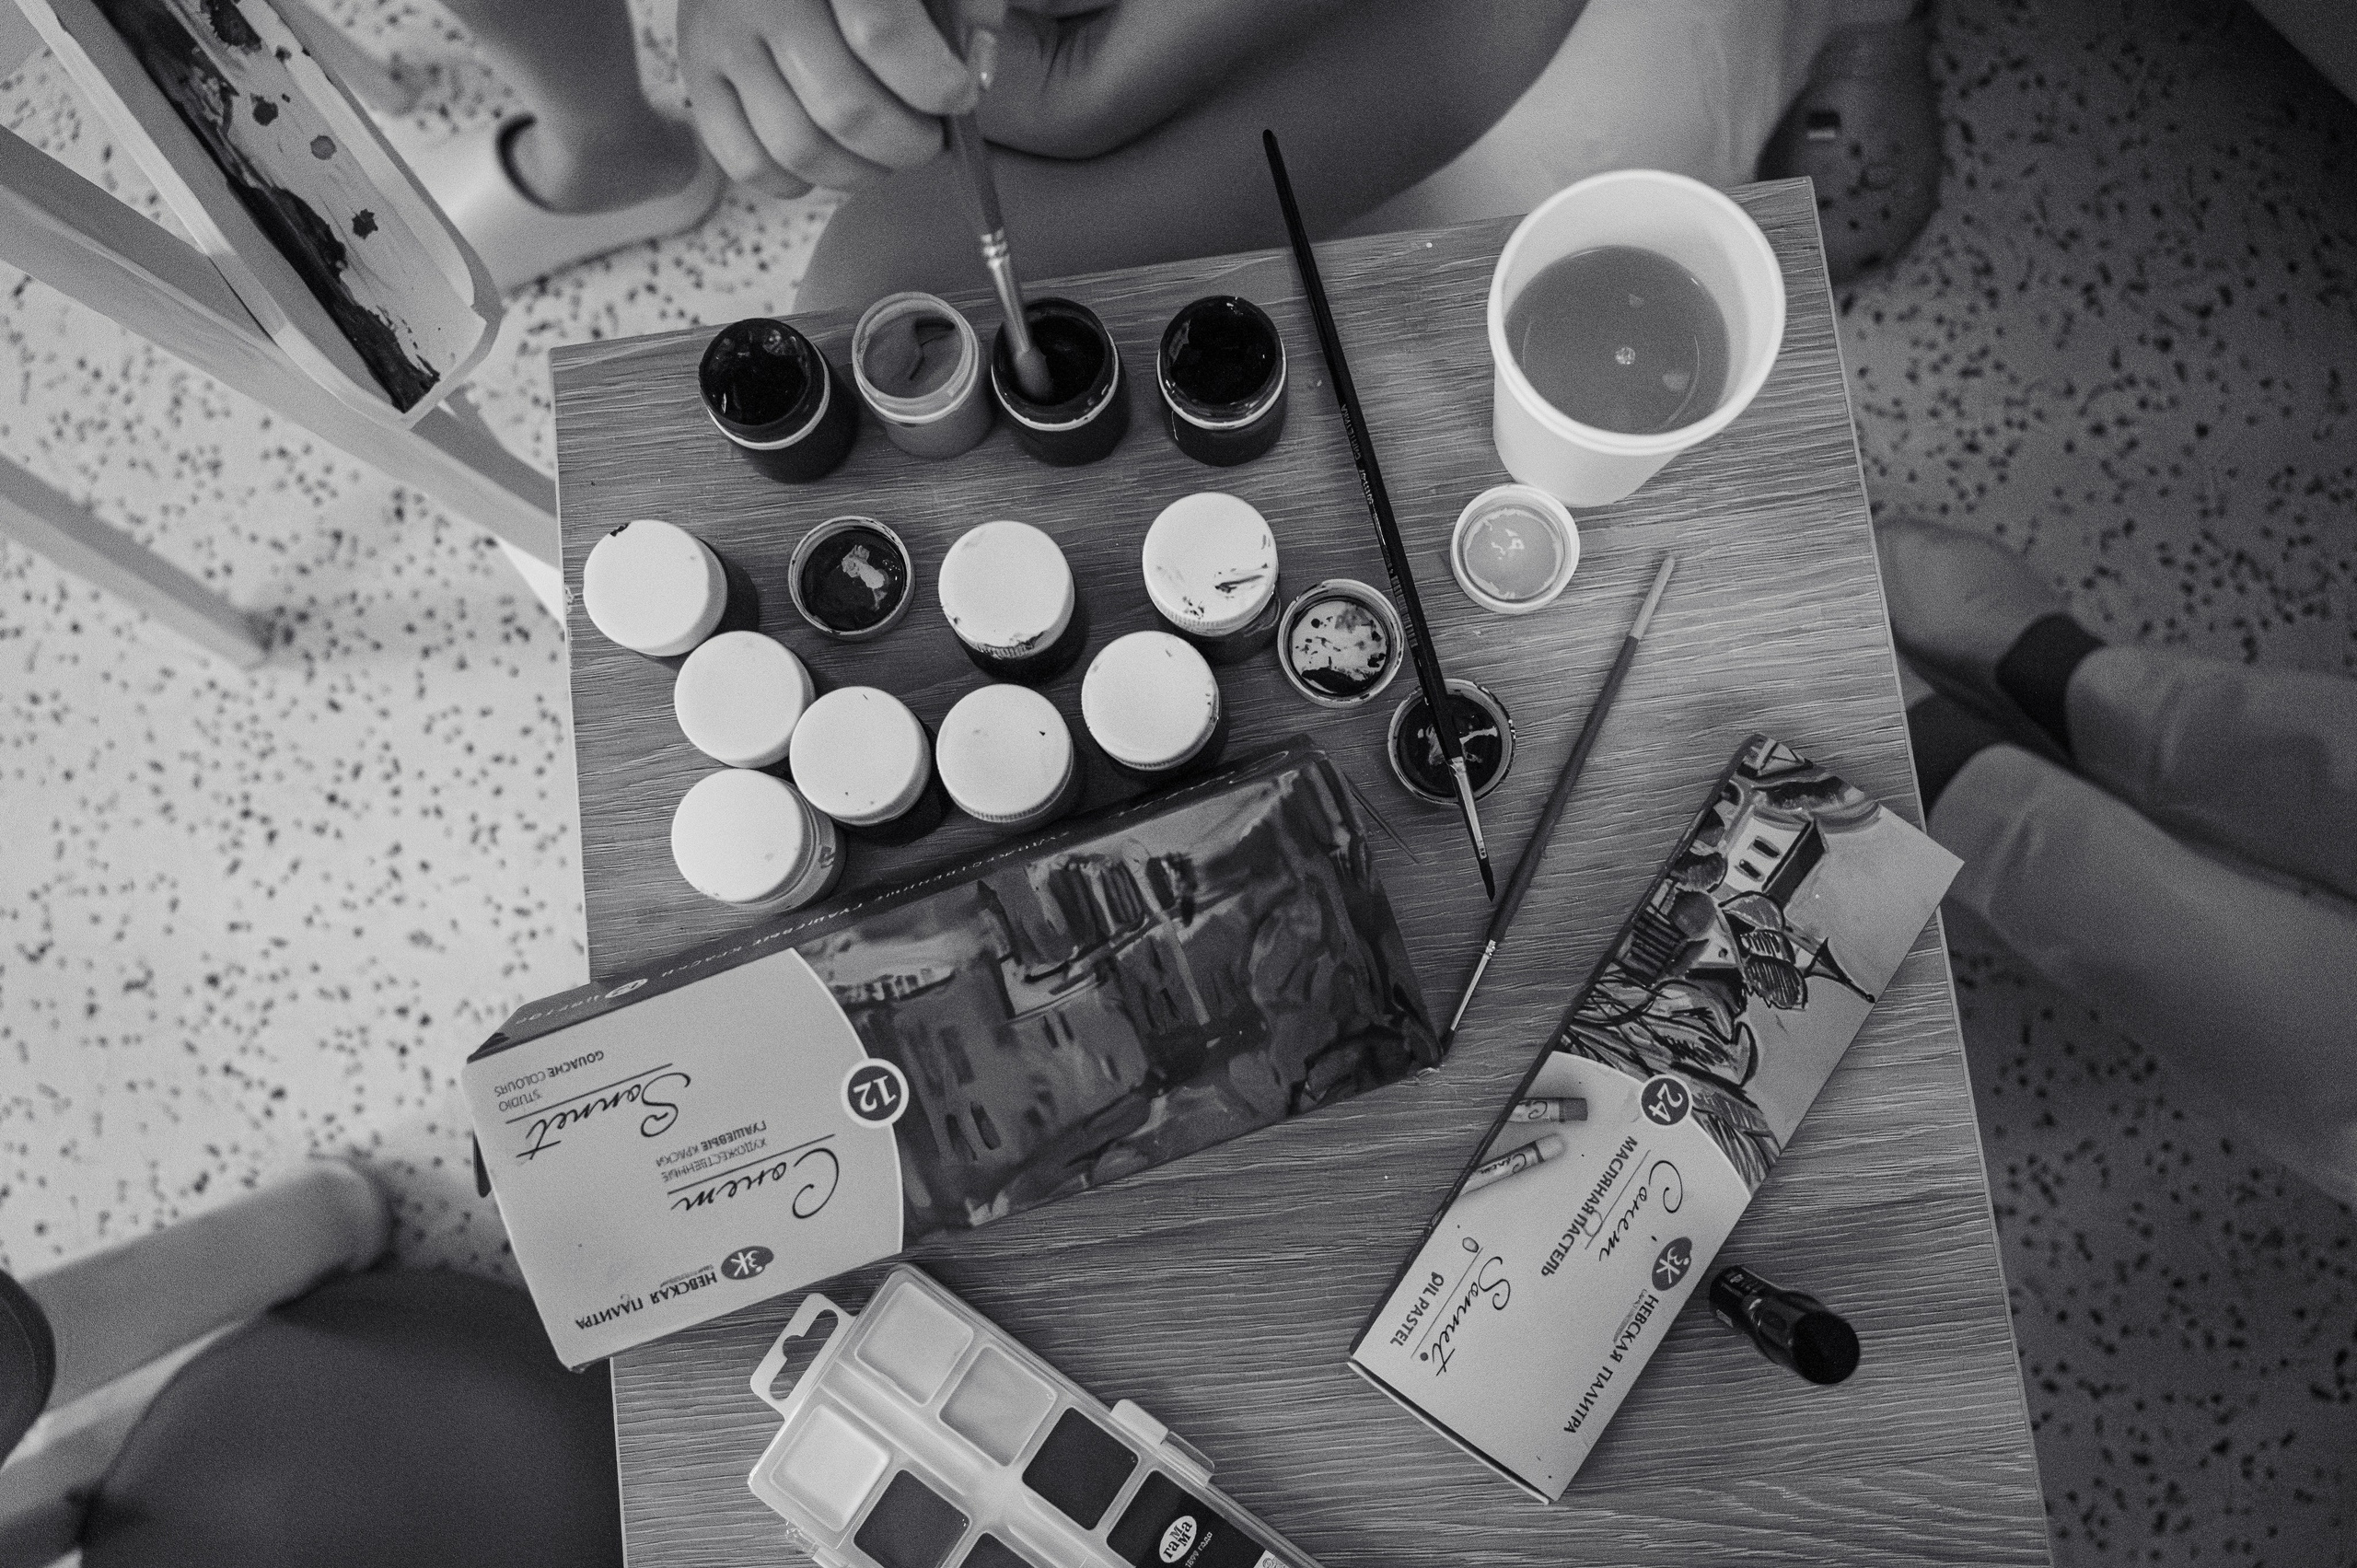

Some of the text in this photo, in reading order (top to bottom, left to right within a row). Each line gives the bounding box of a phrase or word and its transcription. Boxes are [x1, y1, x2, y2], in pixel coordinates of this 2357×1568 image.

[494, 1051, 604, 1095] GOUACHE COLOURS
[499, 1089, 540, 1111] STUDIO
[852, 1076, 896, 1117] 12
[517, 1074, 691, 1160] Sonnet
[1649, 1084, 1684, 1122] 24
[656, 1121, 766, 1167] ГУАШЕВЫЕ КРАСКИ
[661, 1138, 766, 1182] ХУДОЖЕСТВЕННЫЕ
[671, 1147, 840, 1219] Сонет
[1541, 1135, 1639, 1277] МАСЛЯНАЯ ПАСТЕЛЬ
[1599, 1160, 1683, 1260] Сонет
[575, 1298, 643, 1330] ПАЛИТРА
[650, 1273, 717, 1304] НЕВСКАЯ
[1390, 1271, 1445, 1346] OIL PASTEL
[1432, 1253, 1511, 1376] Sonnet
[1610, 1294, 1659, 1363] НЕВСКАЯ
[1564, 1368, 1615, 1434] ПАЛИТРА
